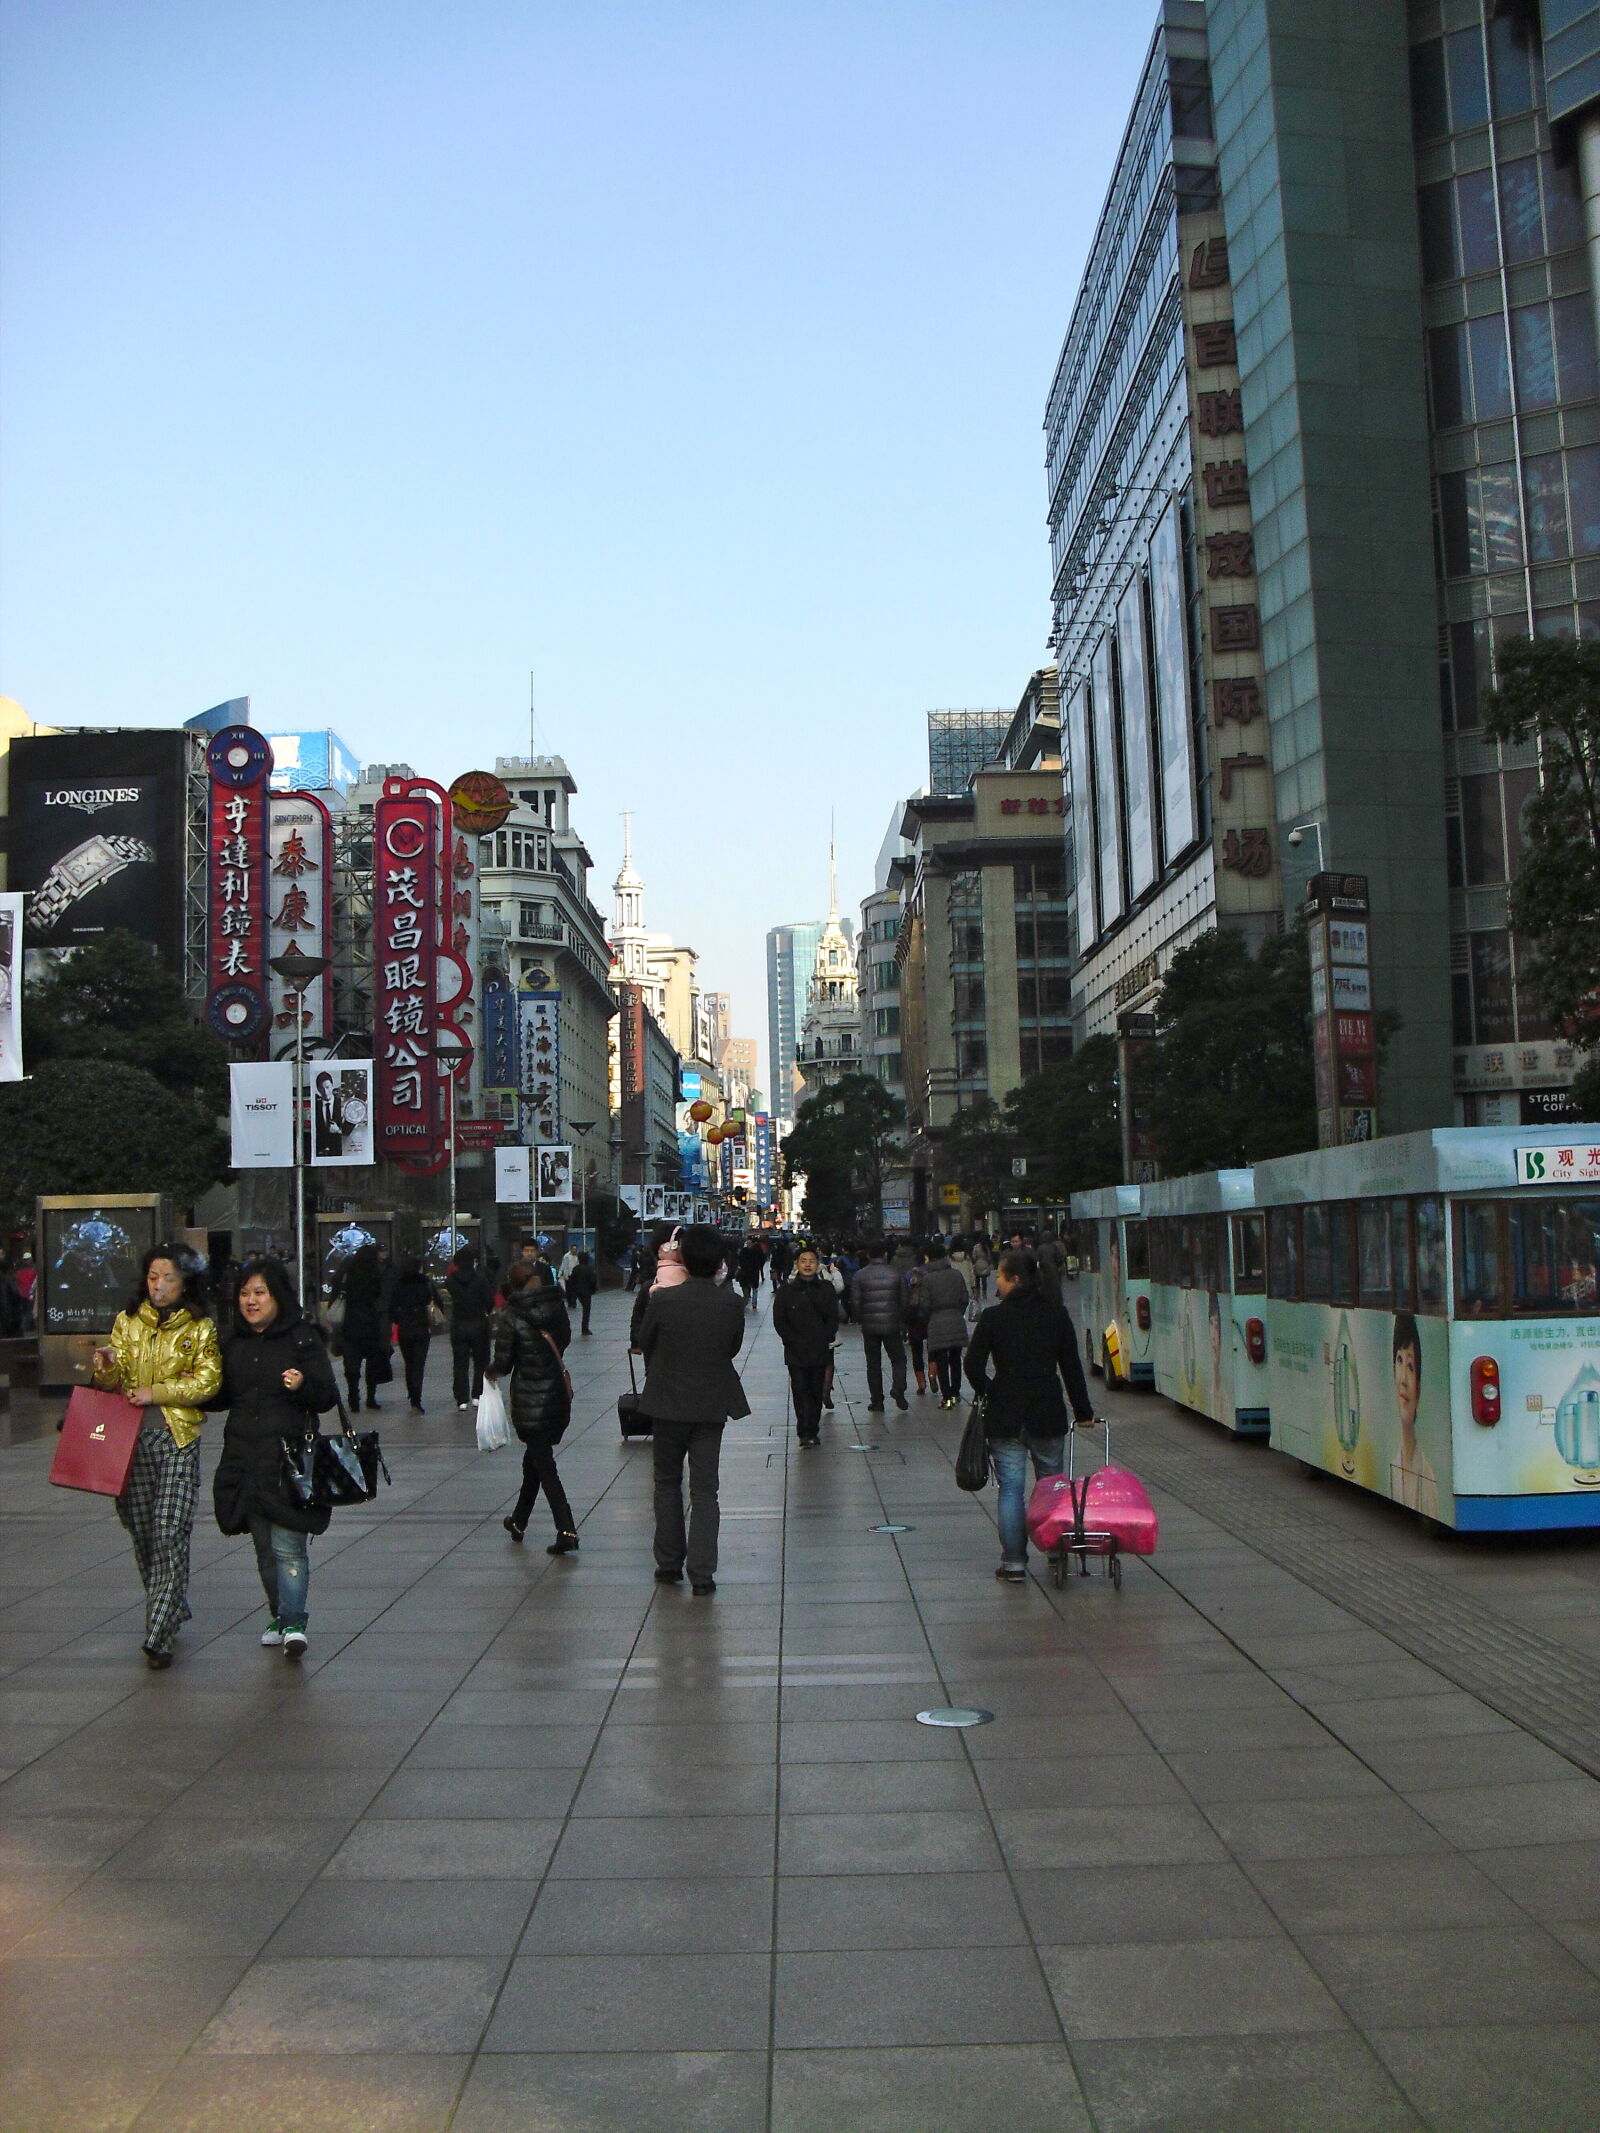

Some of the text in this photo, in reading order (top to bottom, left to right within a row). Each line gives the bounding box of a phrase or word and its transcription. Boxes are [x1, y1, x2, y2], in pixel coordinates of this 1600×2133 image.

[1193, 320, 1272, 876] 百联世茂国际广场
[45, 788, 139, 805] LONGINES
[385, 1124, 428, 1135] OPTICAL
[1552, 1169, 1571, 1179] City
